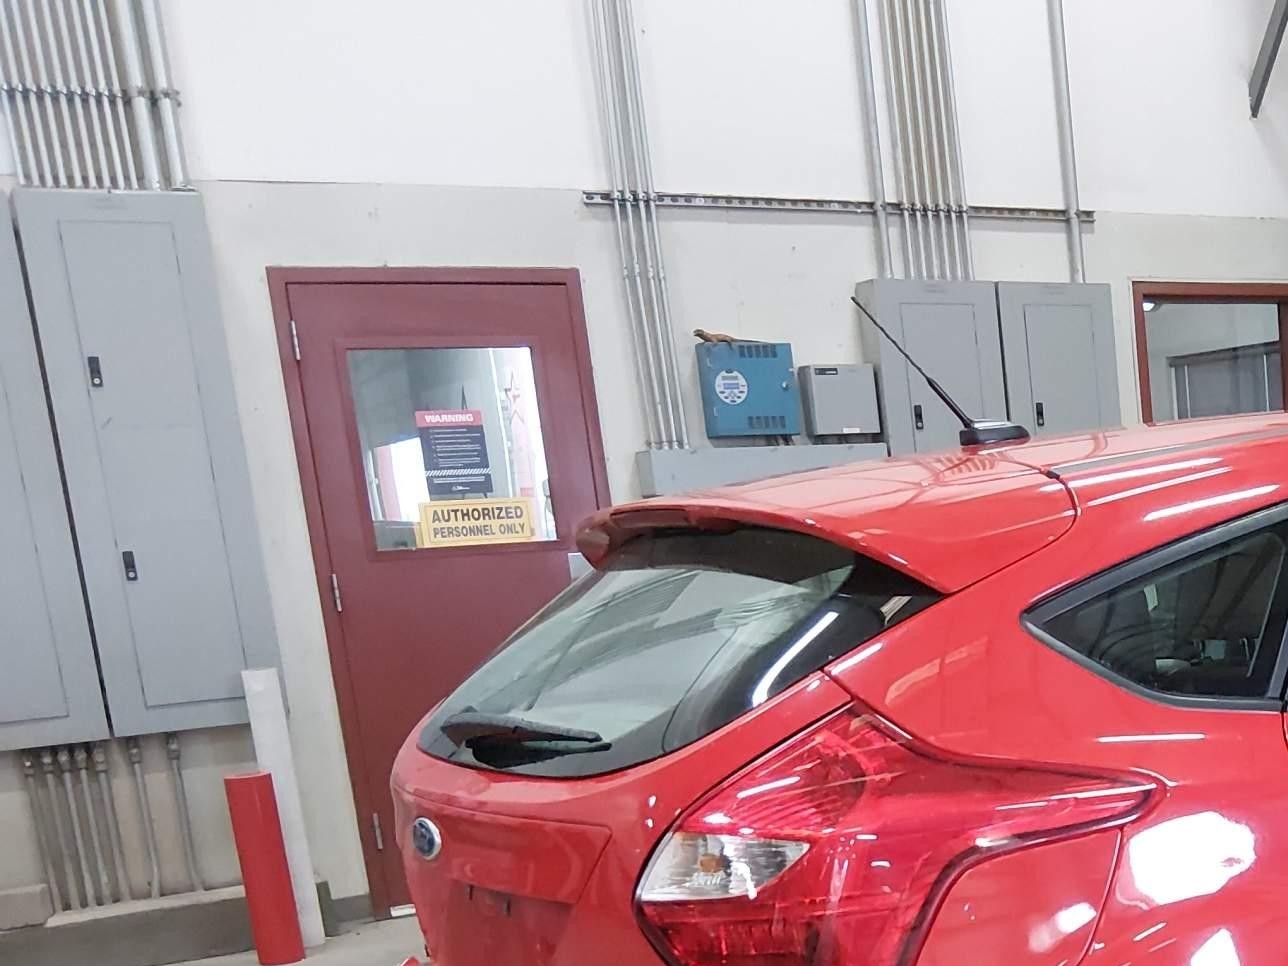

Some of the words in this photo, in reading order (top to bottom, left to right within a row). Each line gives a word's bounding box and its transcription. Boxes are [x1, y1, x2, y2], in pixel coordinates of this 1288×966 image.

[424, 413, 474, 423] WARNING
[432, 506, 524, 523] AUTHORIZED
[433, 524, 496, 538] PERSONNEL
[498, 523, 525, 535] ONLY
